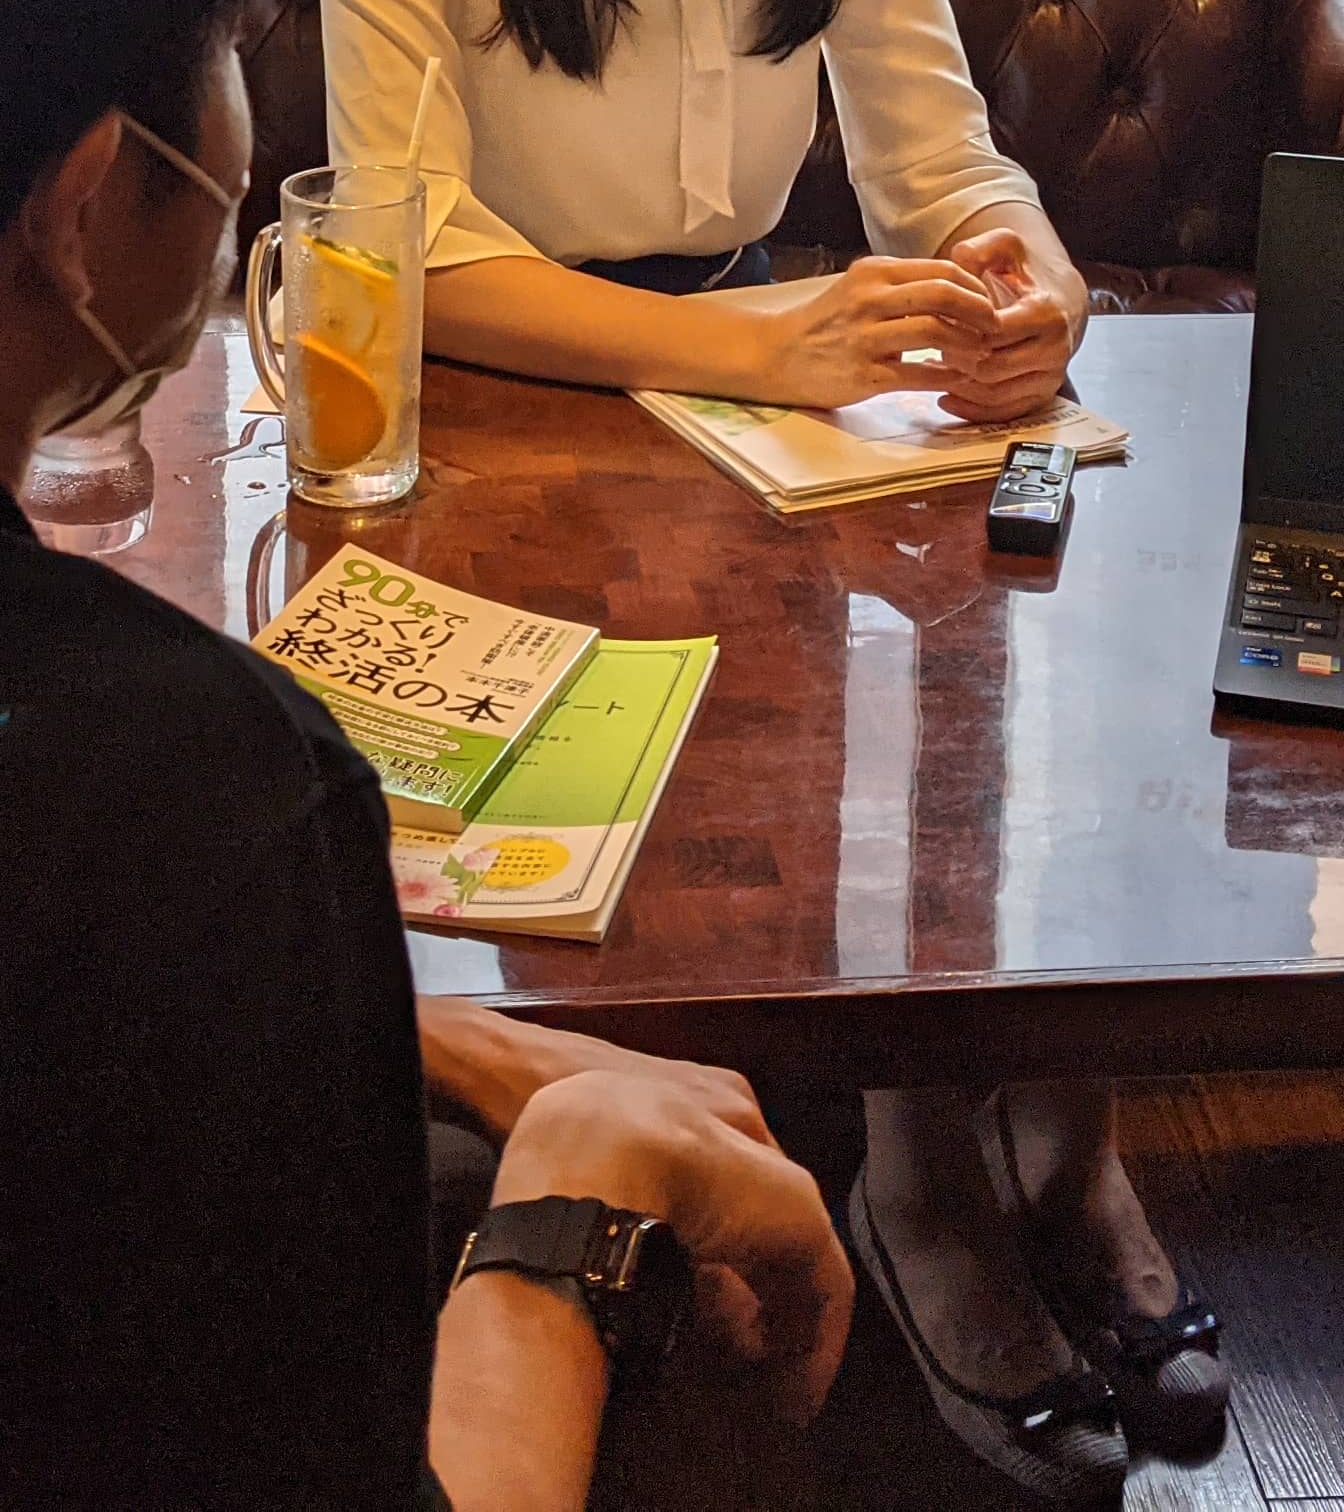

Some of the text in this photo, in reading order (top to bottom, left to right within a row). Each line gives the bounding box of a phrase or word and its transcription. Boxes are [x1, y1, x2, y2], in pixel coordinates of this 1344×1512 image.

[316, 588, 455, 649] ざっくり
[337, 559, 469, 630] 90分で
[267, 628, 515, 724] 終活の本
[556, 700, 625, 716] ート
